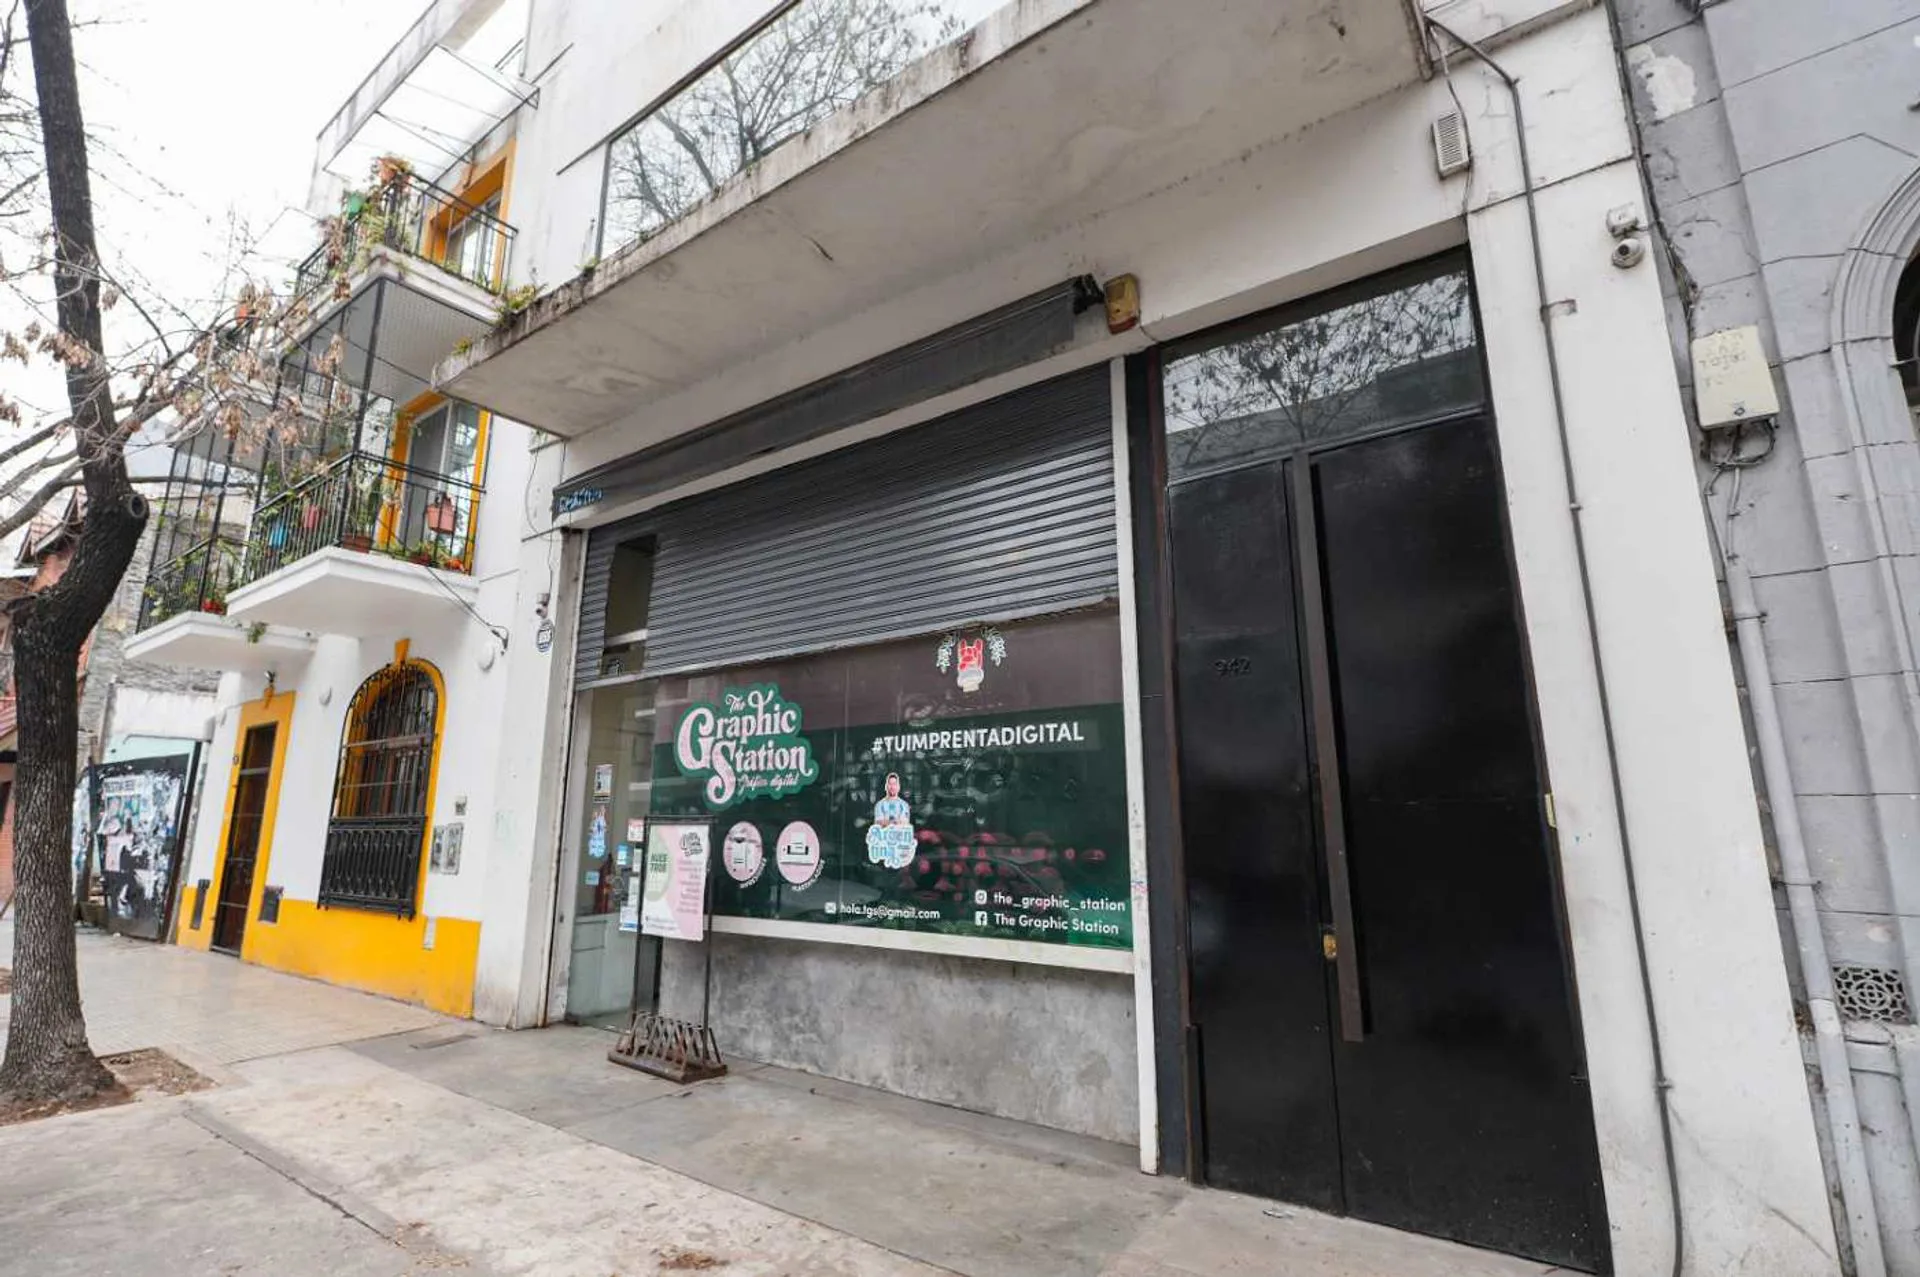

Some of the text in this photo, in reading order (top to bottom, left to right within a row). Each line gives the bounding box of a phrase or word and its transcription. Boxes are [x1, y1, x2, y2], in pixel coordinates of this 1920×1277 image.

[1214, 657, 1250, 674] 942
[725, 693, 746, 712] The
[678, 690, 797, 770] Graphic
[871, 721, 1085, 755] #TUIMPRENTADIGITAL
[706, 739, 813, 804] Station
[840, 903, 940, 920] hola.tgs@gmail.com
[993, 891, 1126, 912] the_graphic_station
[993, 913, 1119, 934] The Graphic Station
